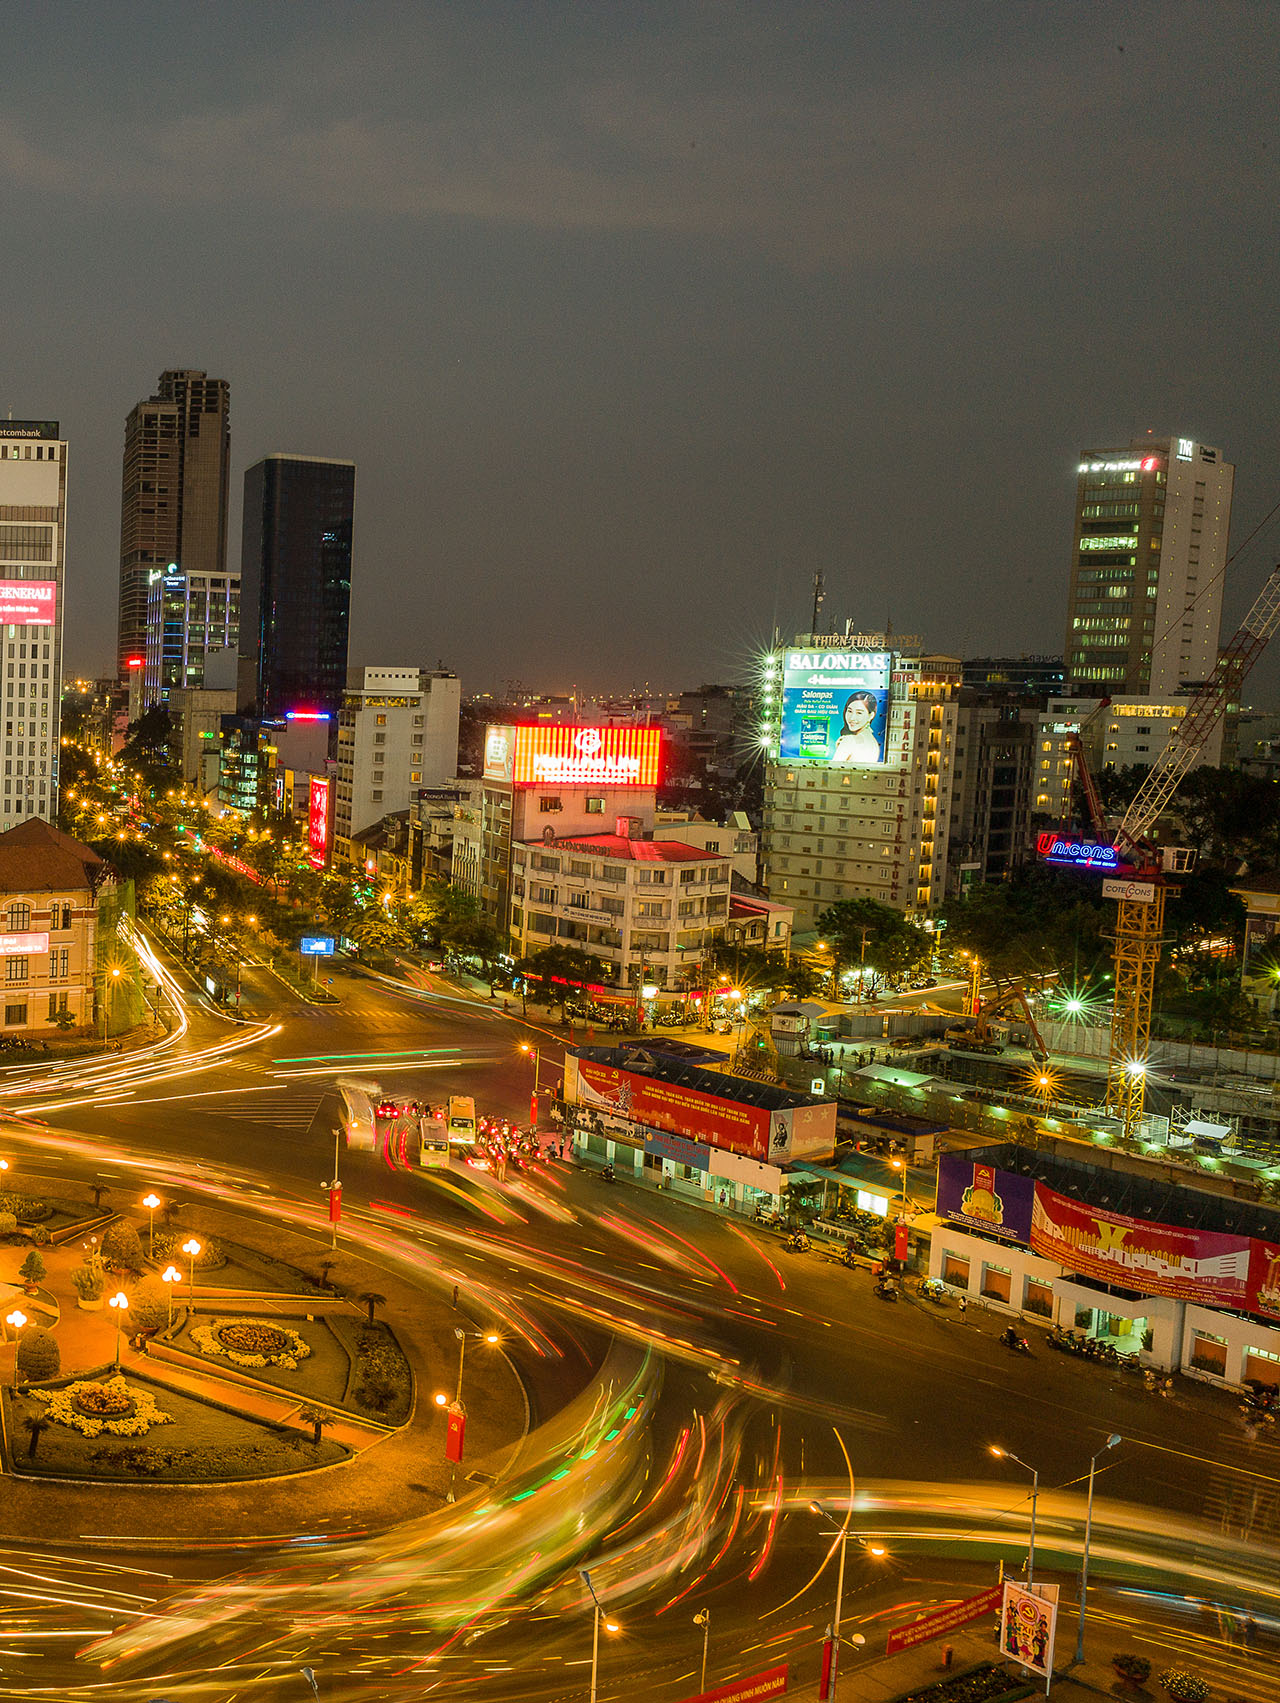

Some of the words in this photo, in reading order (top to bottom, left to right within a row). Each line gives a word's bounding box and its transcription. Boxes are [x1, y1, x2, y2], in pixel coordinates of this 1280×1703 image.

[813, 632, 847, 647] THIÊN
[850, 632, 878, 647] TÙNG
[802, 690, 833, 700] Salonpas
[1023, 1626, 1034, 1636] XII
